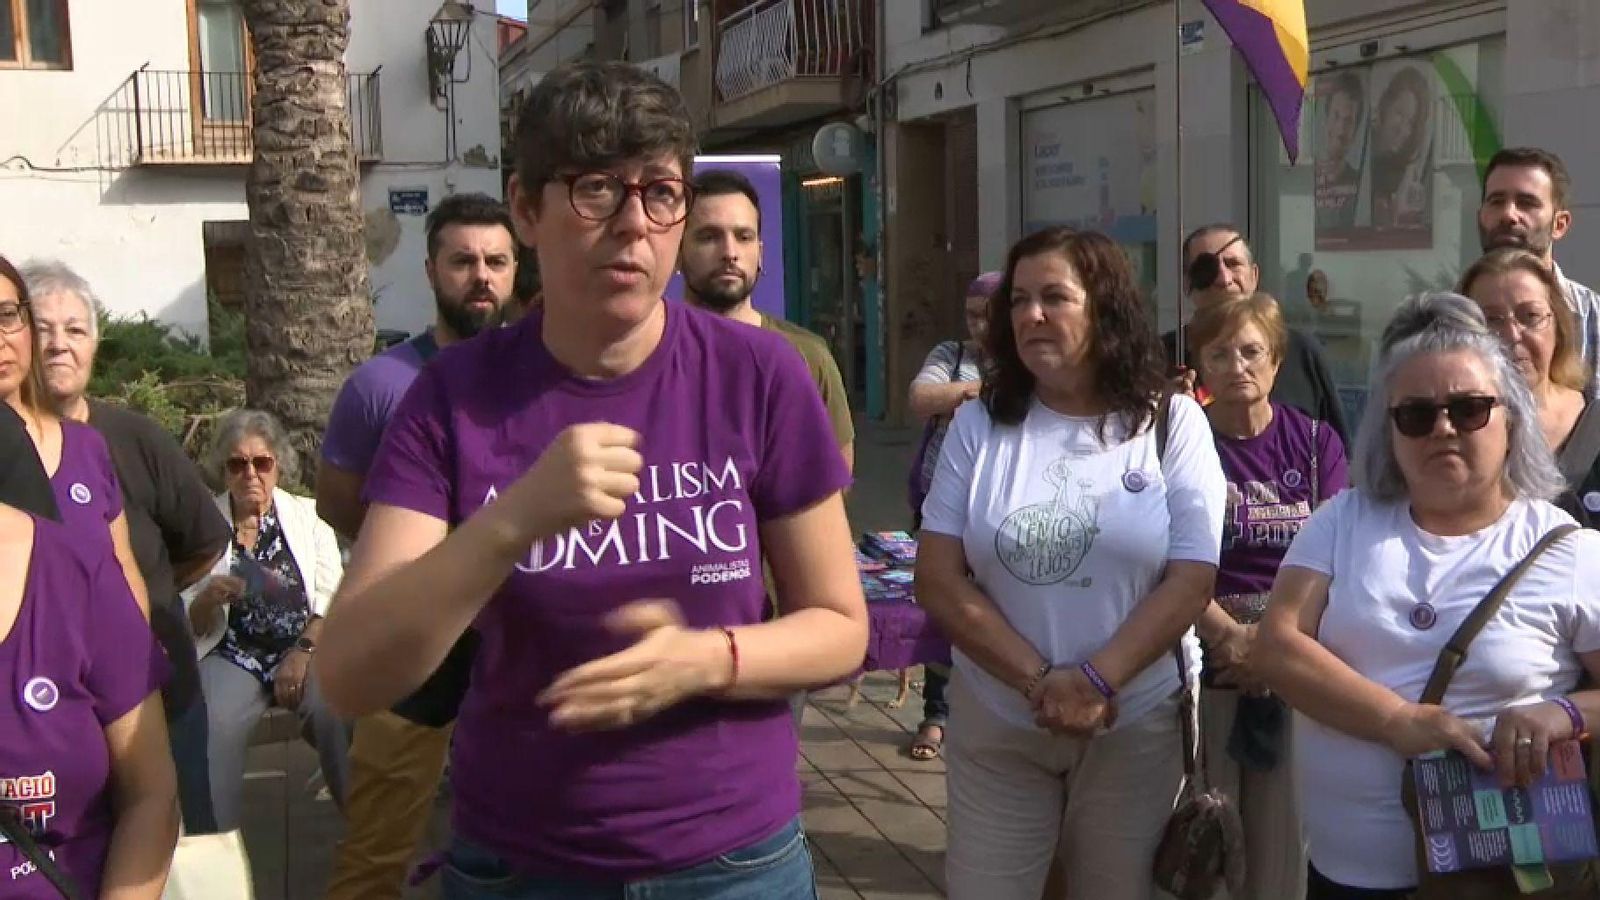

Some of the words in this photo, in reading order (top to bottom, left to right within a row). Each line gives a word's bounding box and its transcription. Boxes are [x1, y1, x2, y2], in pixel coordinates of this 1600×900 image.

[514, 499, 748, 573] OMING
[588, 518, 602, 537] IS
[691, 568, 751, 585] PODEMOS
